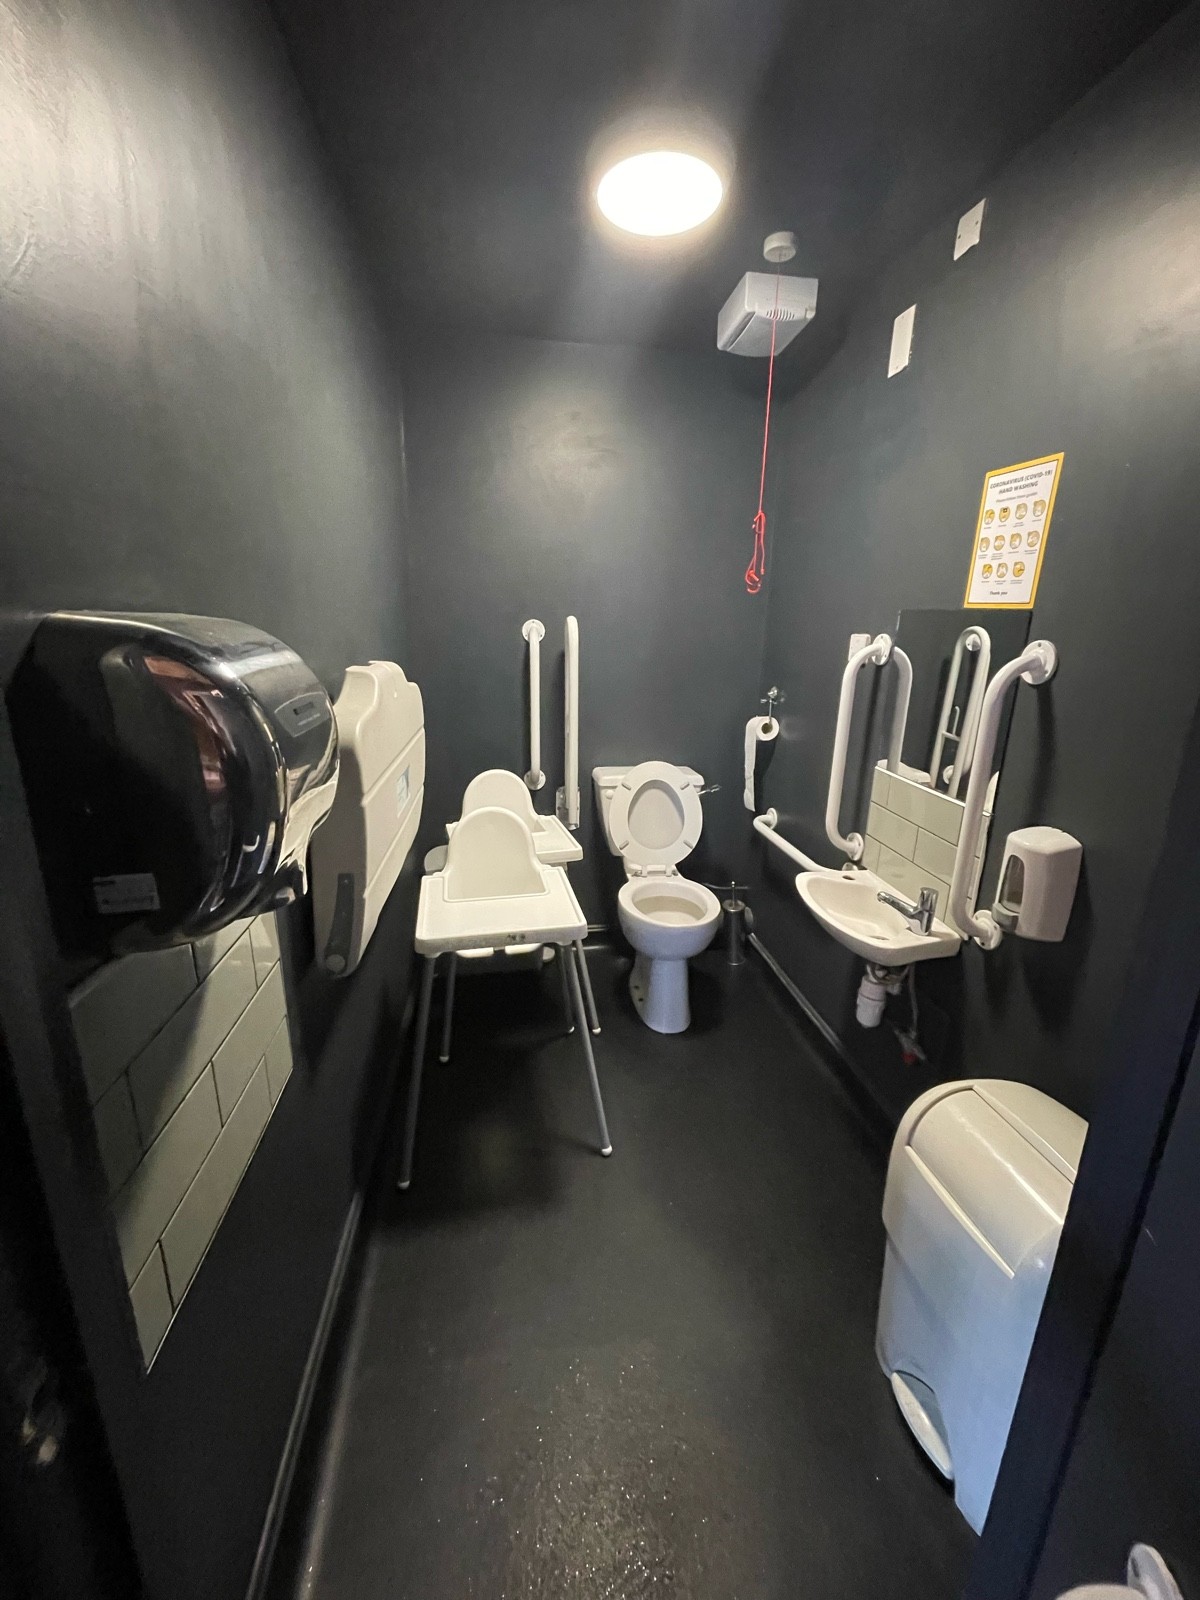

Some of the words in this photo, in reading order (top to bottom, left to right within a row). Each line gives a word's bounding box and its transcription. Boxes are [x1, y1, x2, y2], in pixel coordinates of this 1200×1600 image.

[990, 476, 1024, 489] CORONAVIRUS
[1024, 469, 1053, 482] (COVID-19)
[998, 486, 1013, 495] HAND
[1013, 480, 1039, 491] WASHING
